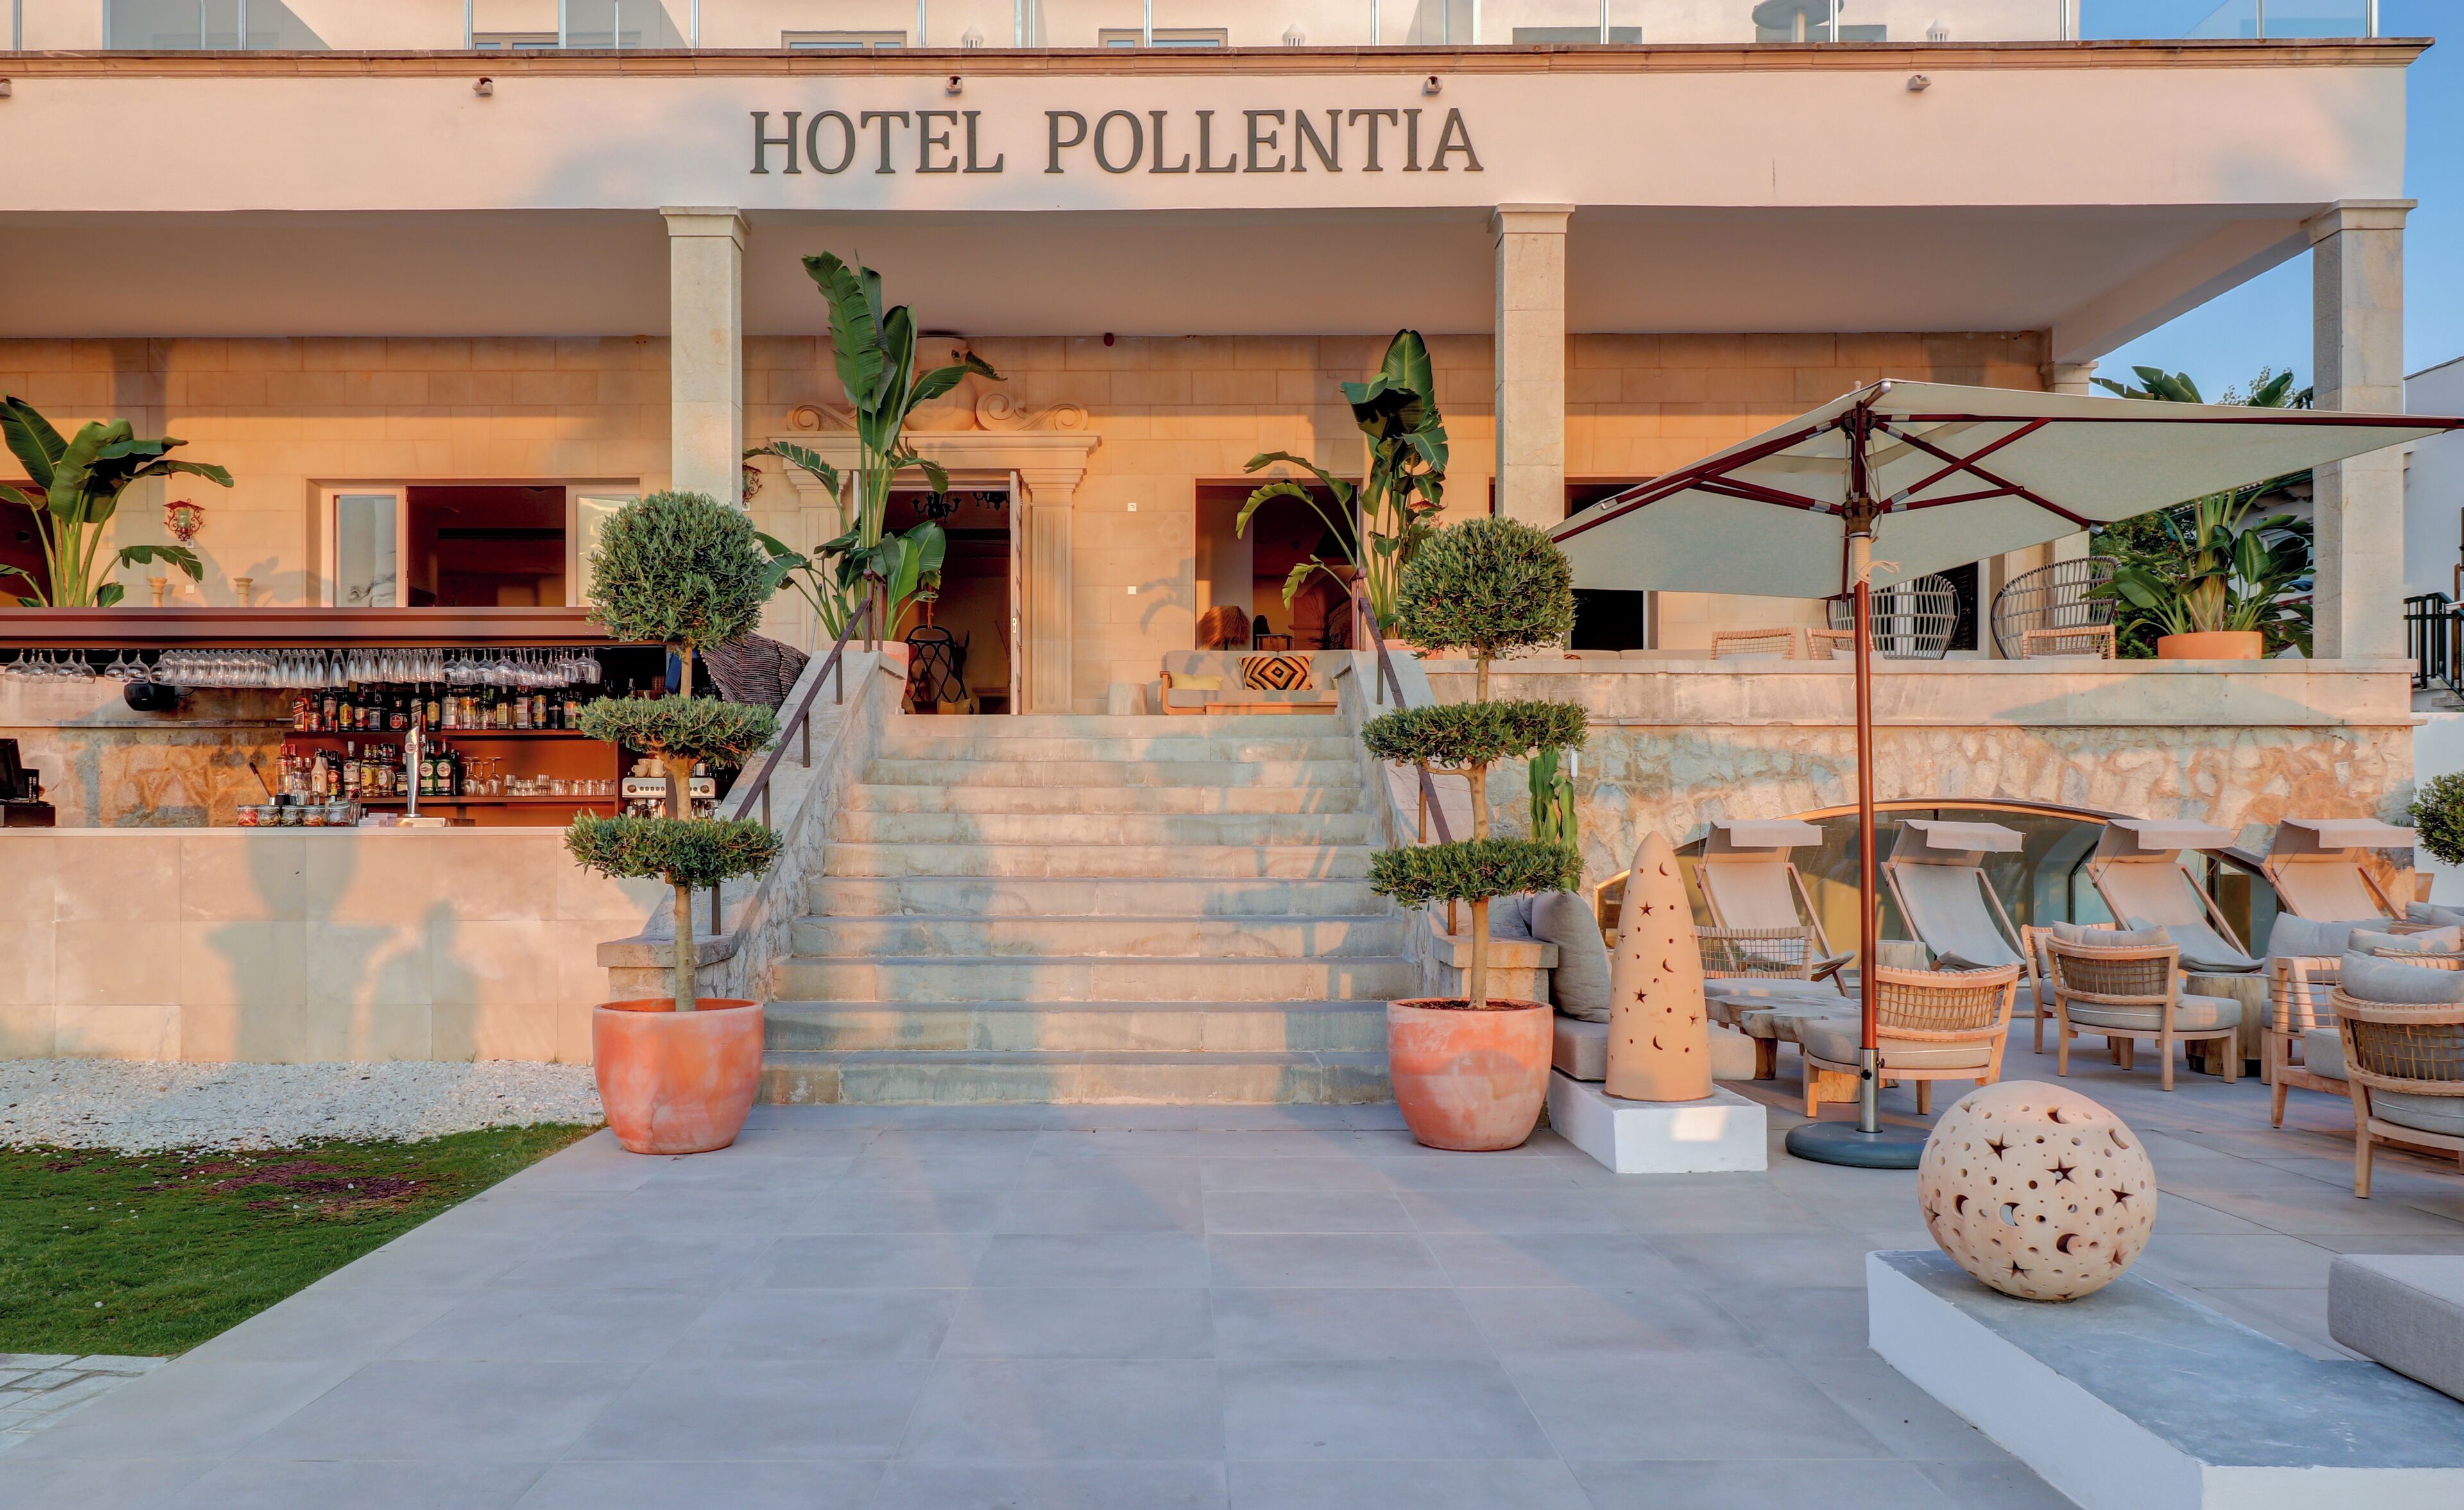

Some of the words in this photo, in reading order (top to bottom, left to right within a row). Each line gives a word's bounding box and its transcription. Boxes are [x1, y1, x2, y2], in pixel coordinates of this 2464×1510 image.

[749, 110, 1004, 175] HOTEL
[1044, 107, 1484, 174] POLLENTIA
[341, 708, 352, 719] JB
